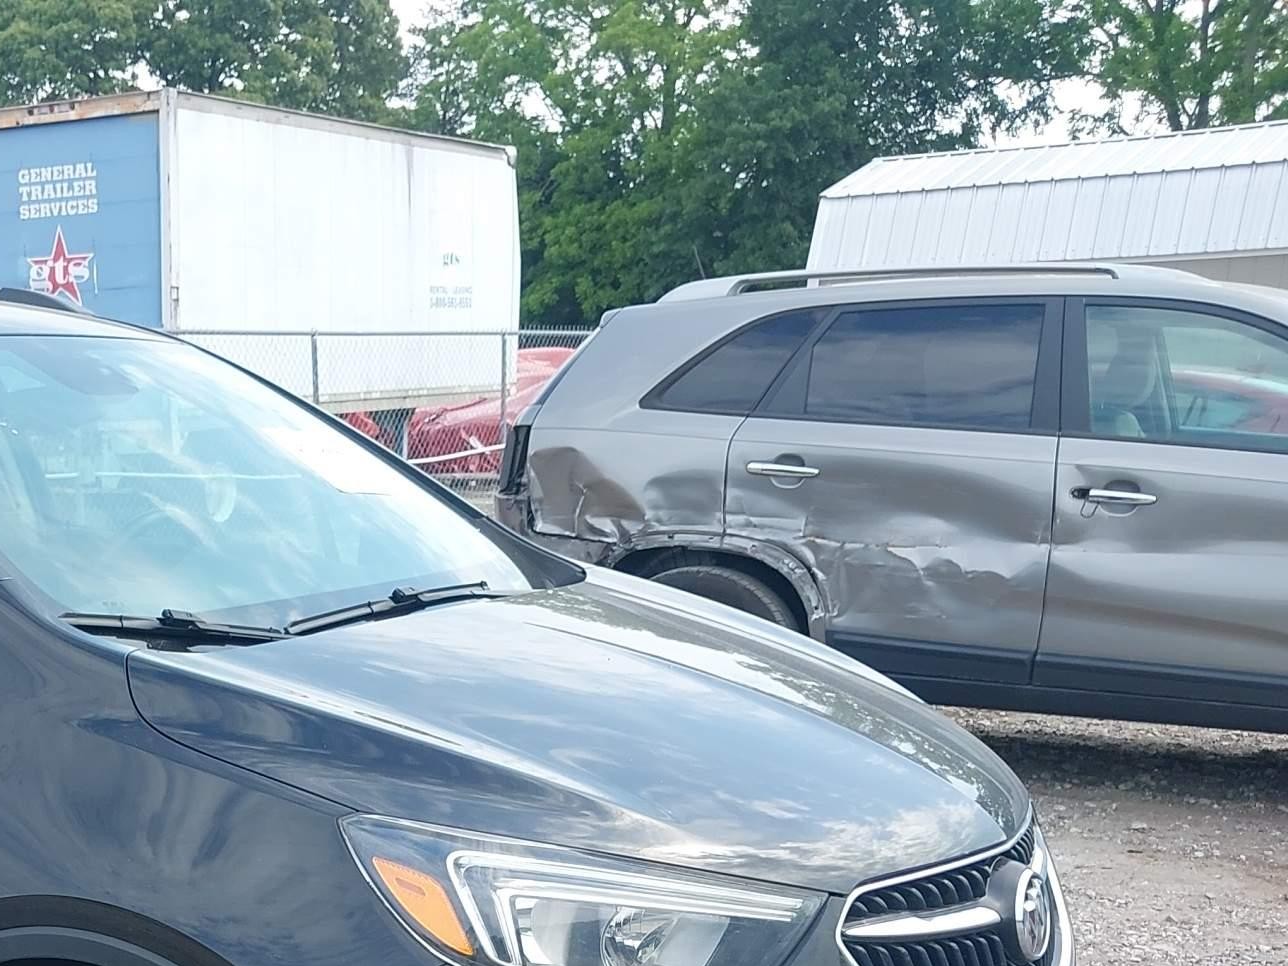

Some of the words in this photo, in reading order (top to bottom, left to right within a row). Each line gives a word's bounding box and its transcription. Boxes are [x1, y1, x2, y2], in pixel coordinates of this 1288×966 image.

[18, 162, 97, 184] GENERAL
[18, 180, 97, 202] TRAILER
[19, 198, 99, 220] SERVICES
